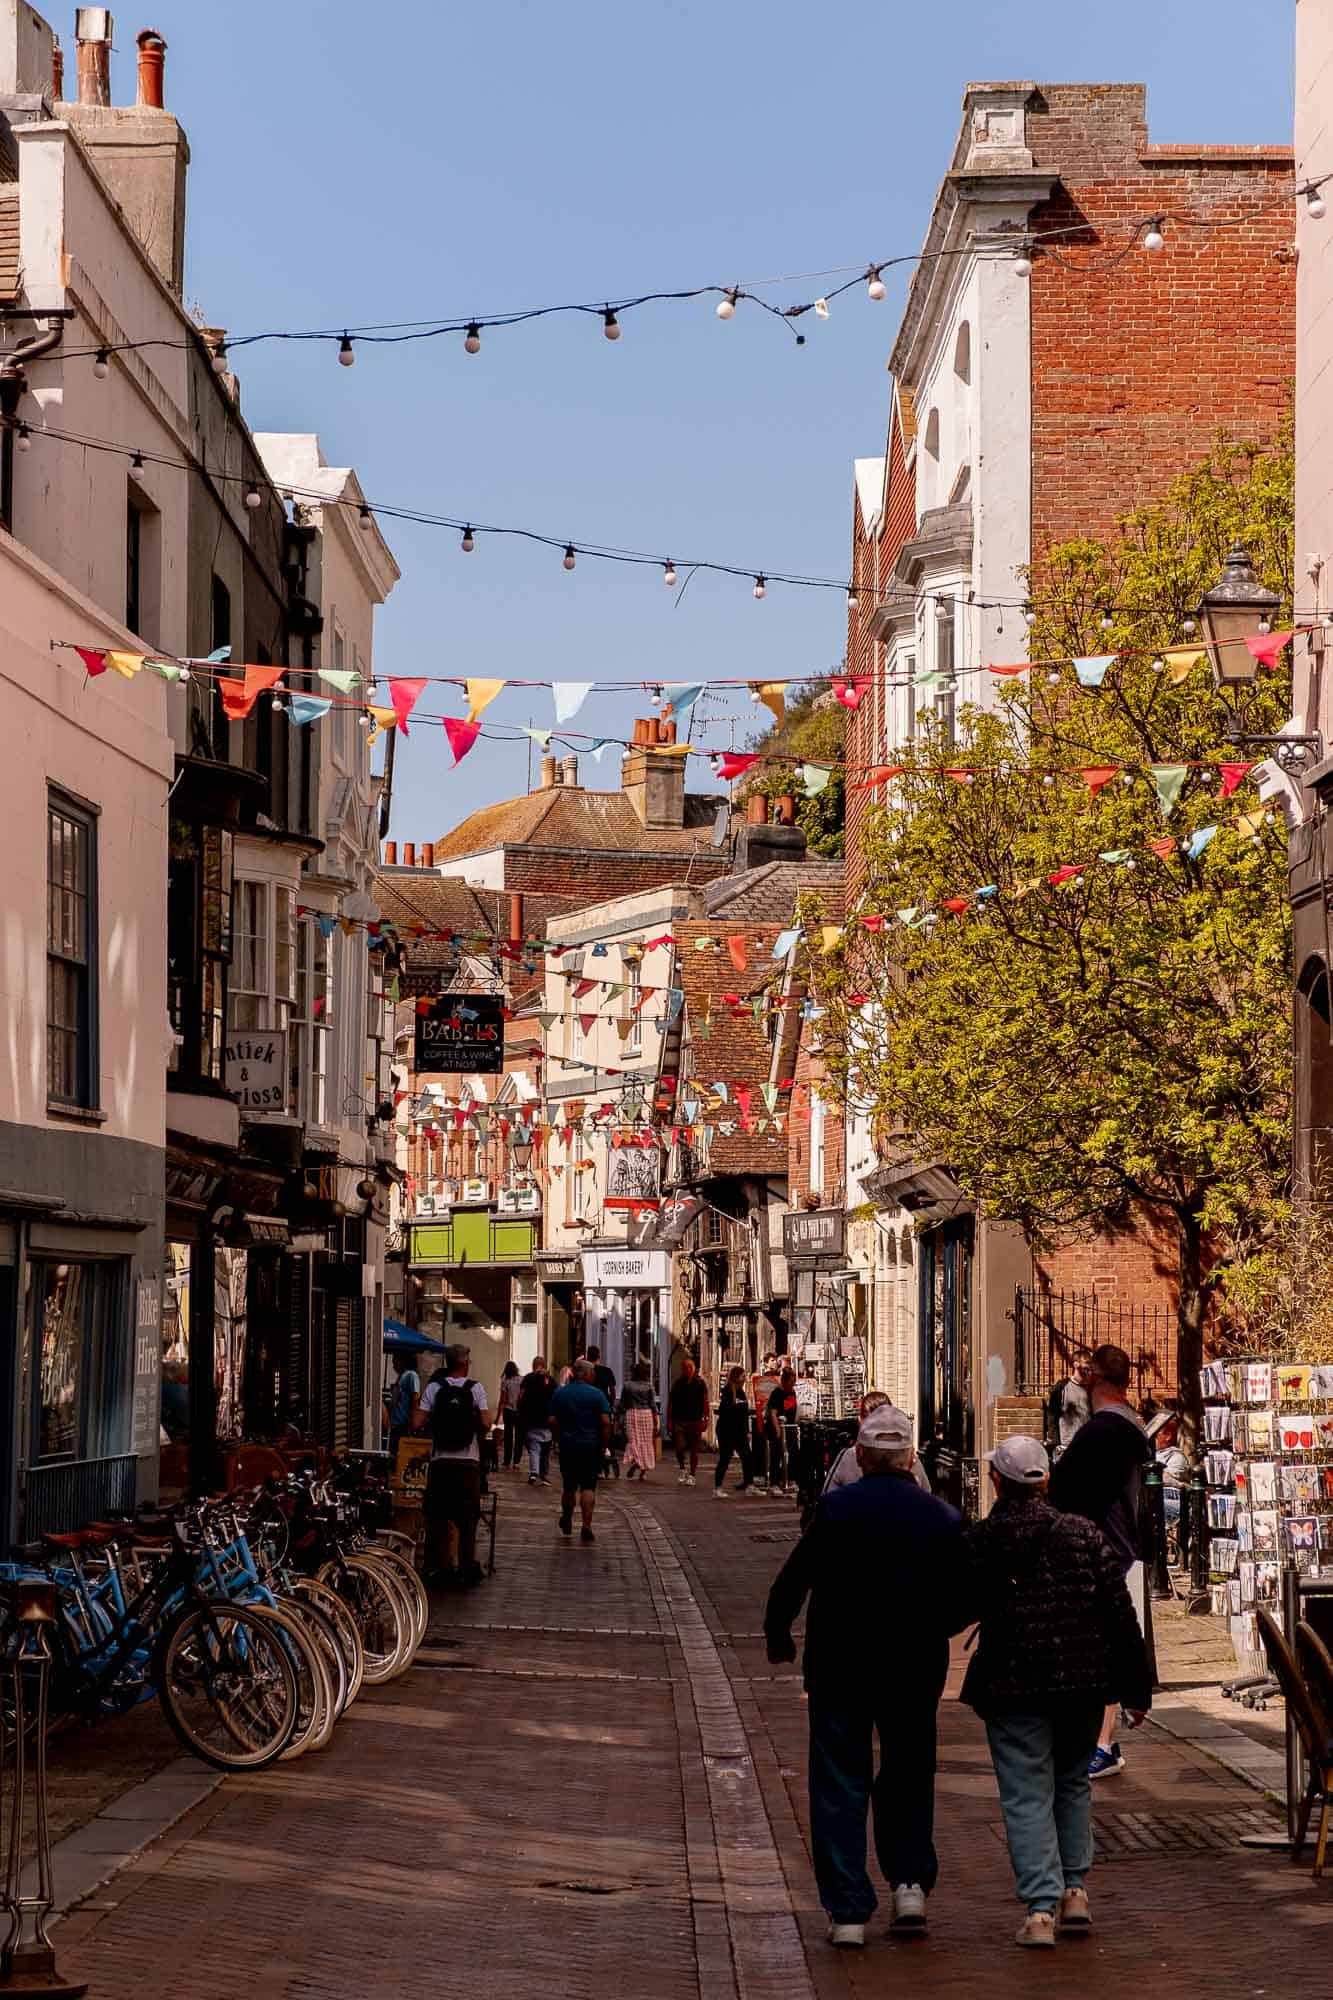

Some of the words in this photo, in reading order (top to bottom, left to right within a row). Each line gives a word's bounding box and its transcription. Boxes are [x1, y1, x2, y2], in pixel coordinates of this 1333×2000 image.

[423, 1049, 460, 1060] COFFEE
[469, 1050, 496, 1061] WINE
[240, 1066, 249, 1082] &
[625, 1260, 644, 1275] BAKERY
[138, 1287, 159, 1327] Bike
[136, 1335, 158, 1376] Hire
